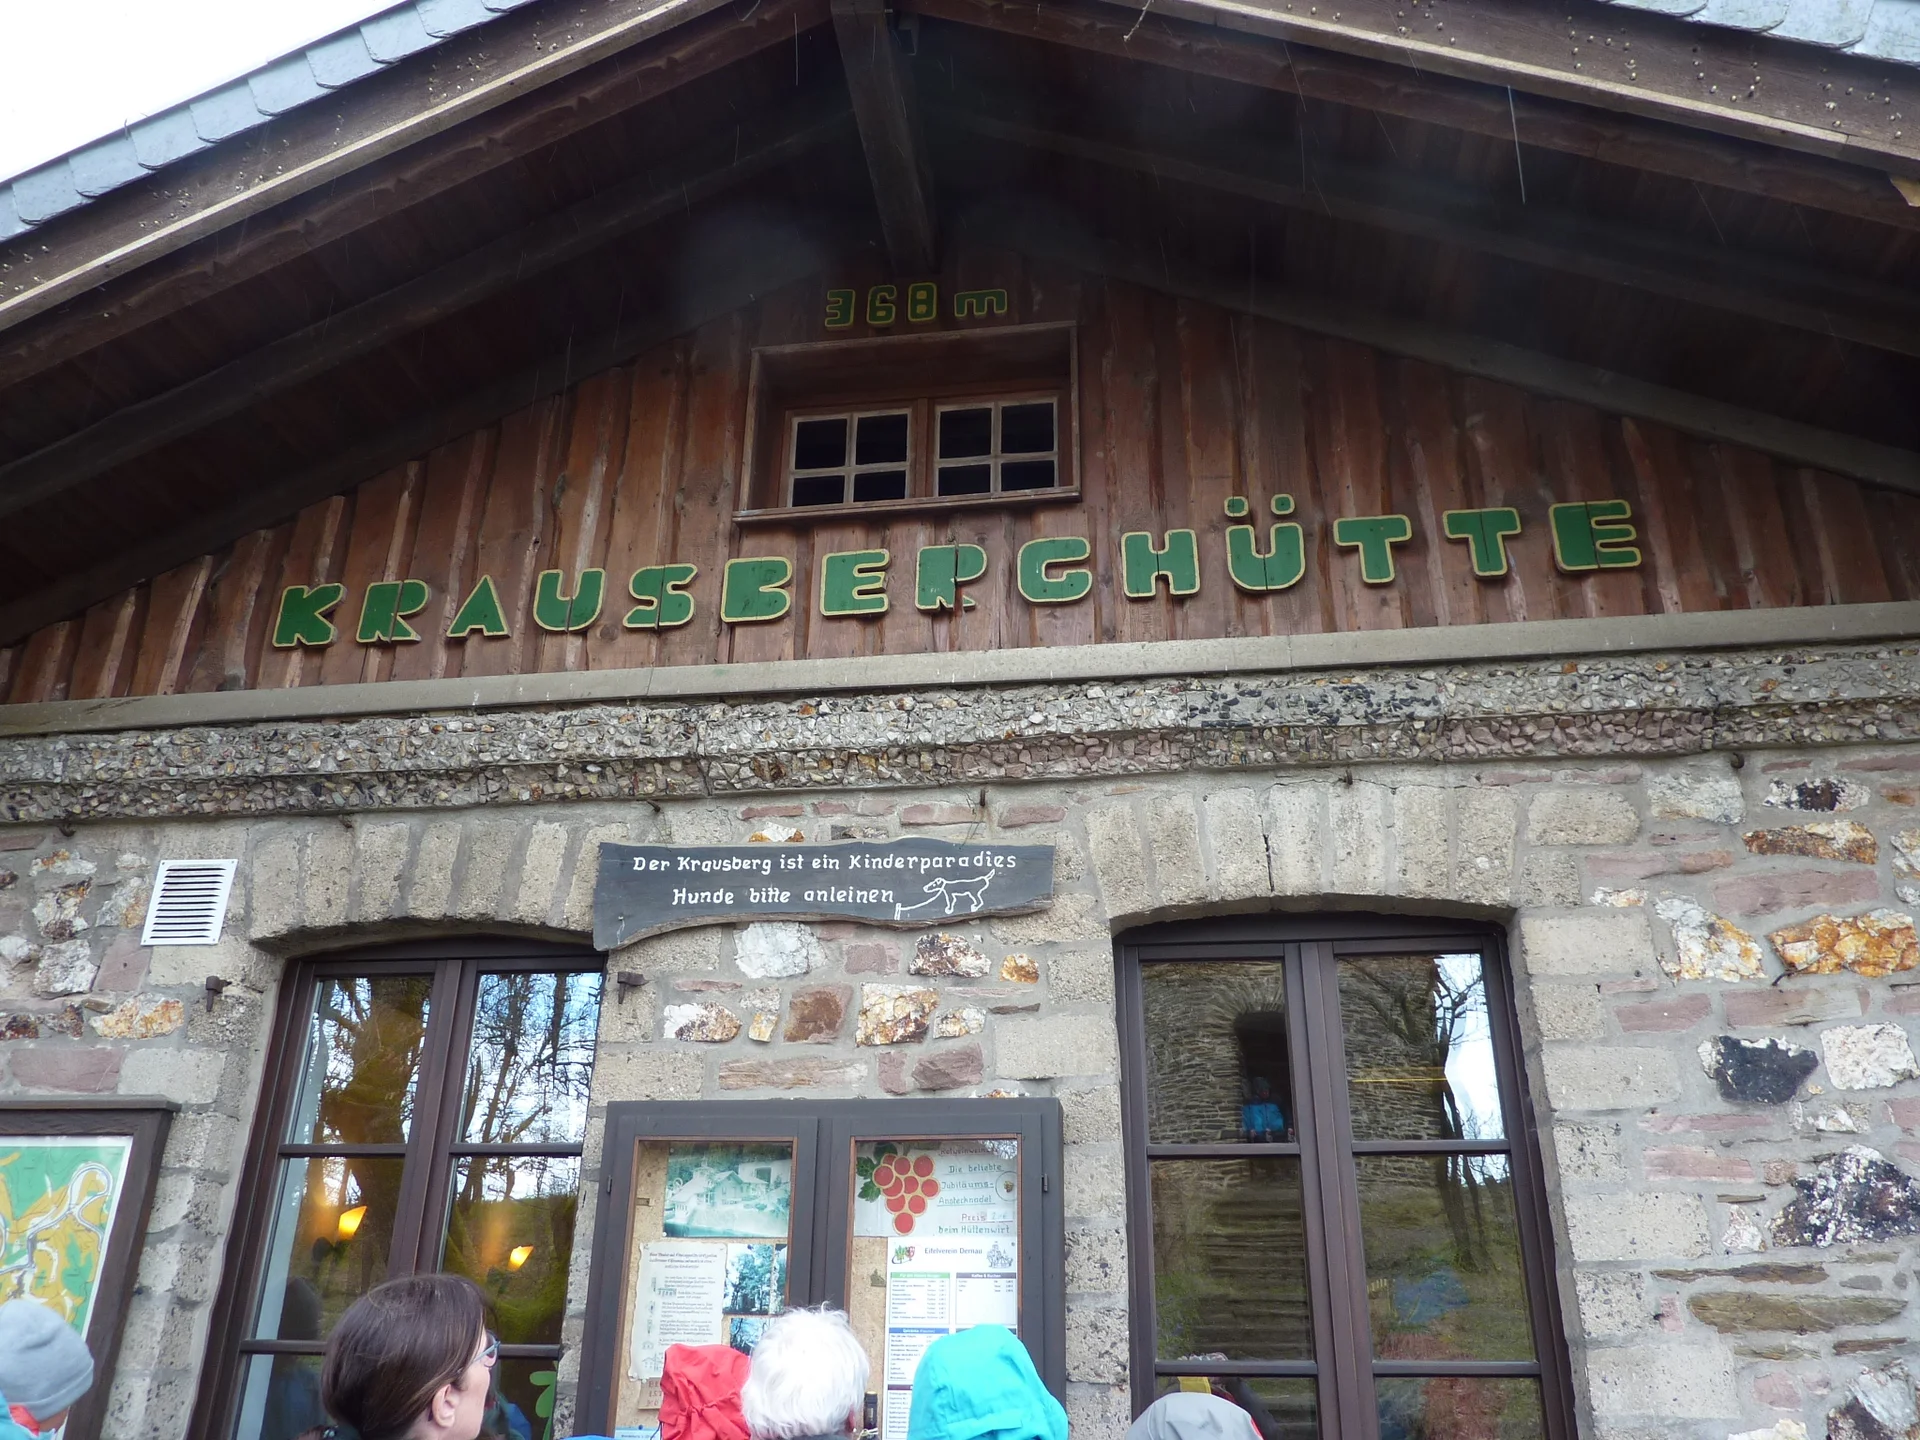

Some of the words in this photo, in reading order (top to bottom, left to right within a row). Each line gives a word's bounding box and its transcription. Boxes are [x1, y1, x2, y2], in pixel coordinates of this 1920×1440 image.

[825, 283, 937, 328] 368
[954, 289, 1008, 318] m
[271, 493, 1644, 648] KRAUSBERGHÜTTE
[633, 856, 670, 871] Der
[677, 856, 771, 875] Krausberg
[780, 854, 804, 869] ist
[811, 853, 840, 869] ein
[848, 851, 1017, 874] Kinderparadies
[672, 888, 734, 905] Hunde
[749, 886, 791, 903] bitte
[803, 886, 893, 903] anleinen
[968, 1163, 1003, 1173] beliebte
[961, 1213, 987, 1222] Preis
[938, 1225, 958, 1235] beim
[961, 1225, 1010, 1235] Hüttenwirt
[924, 1247, 958, 1255] Eifelverein
[959, 1247, 983, 1255] Dernau
